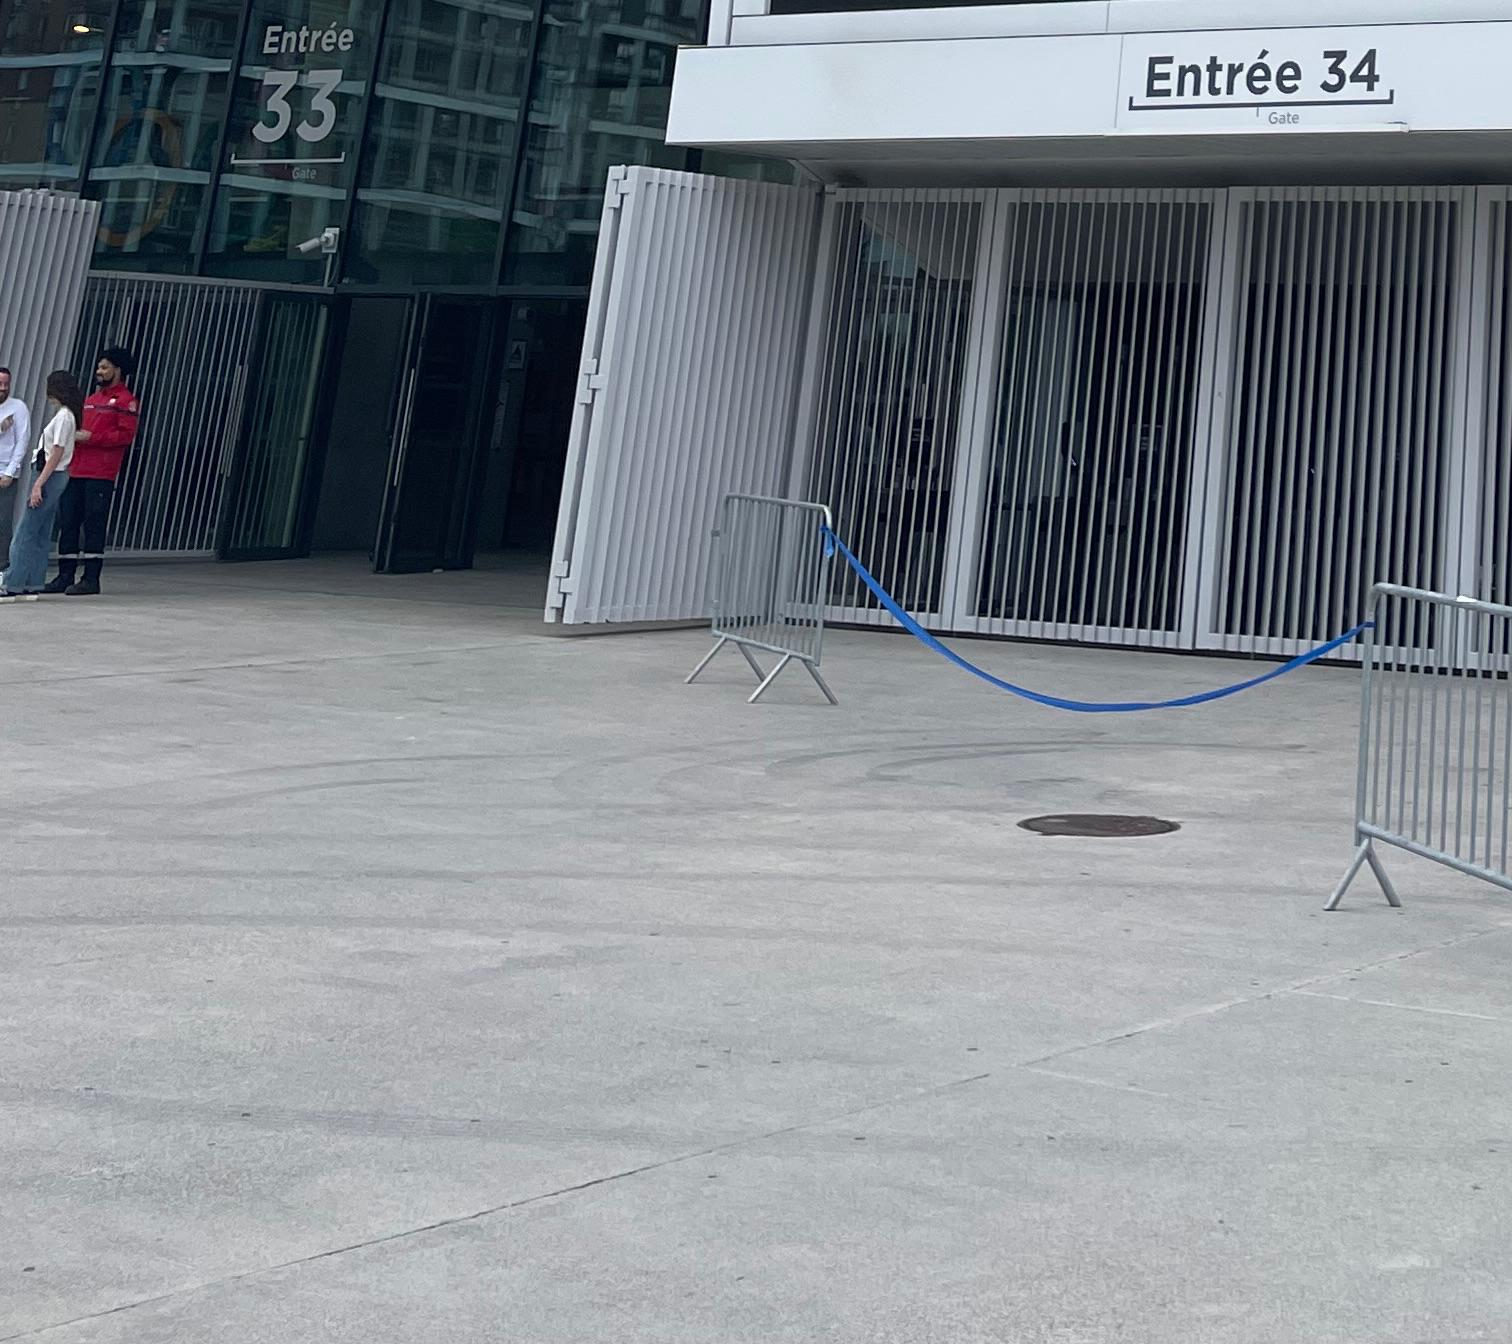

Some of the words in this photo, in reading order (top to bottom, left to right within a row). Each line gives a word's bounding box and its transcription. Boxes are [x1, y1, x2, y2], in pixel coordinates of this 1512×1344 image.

[263, 21, 354, 54] Entrée
[1146, 49, 1302, 98] Entrée
[1320, 48, 1380, 94] 34
[252, 69, 343, 143] 33
[1268, 111, 1300, 125] Gate
[292, 167, 317, 180] Gate
